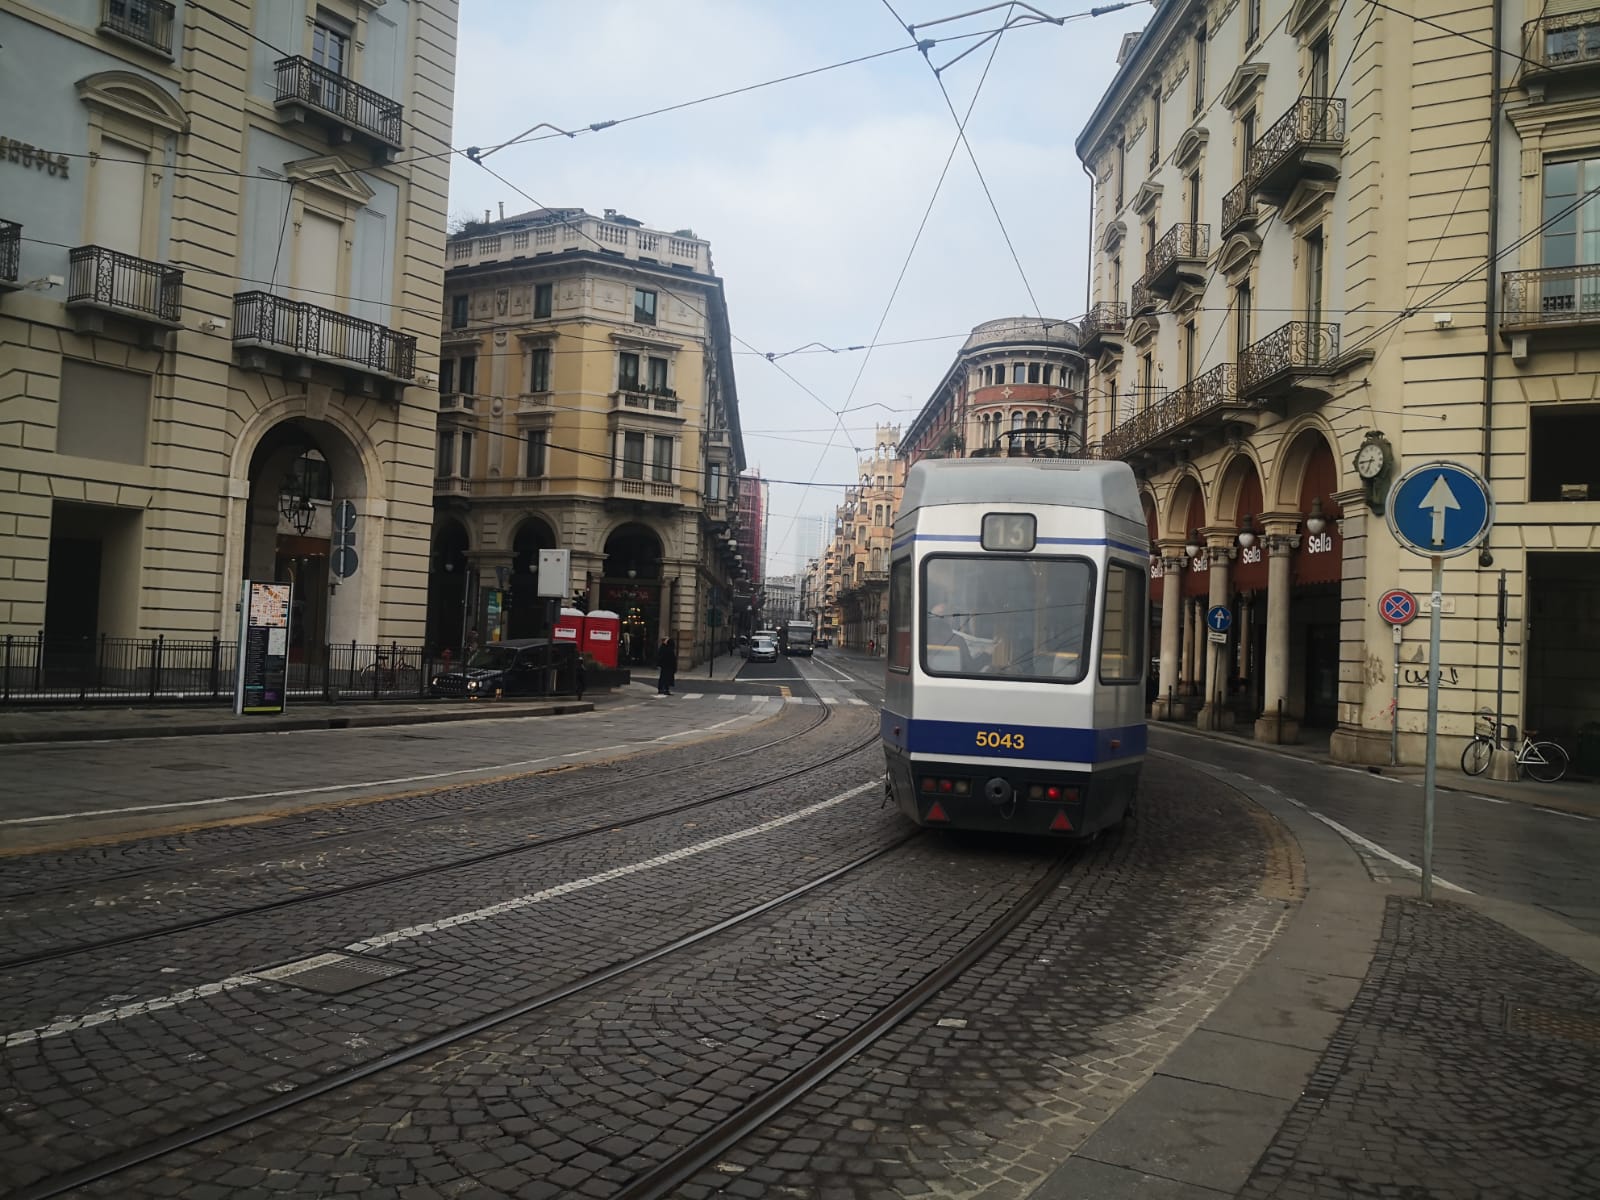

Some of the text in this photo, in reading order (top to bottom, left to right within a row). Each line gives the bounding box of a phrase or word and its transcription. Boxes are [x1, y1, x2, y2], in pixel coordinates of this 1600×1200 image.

[1308, 533, 1332, 554] Sella
[1243, 546, 1261, 564] Sella
[1151, 565, 1163, 578] Sella
[1193, 558, 1207, 572] Sella
[976, 731, 1025, 749] 5043
